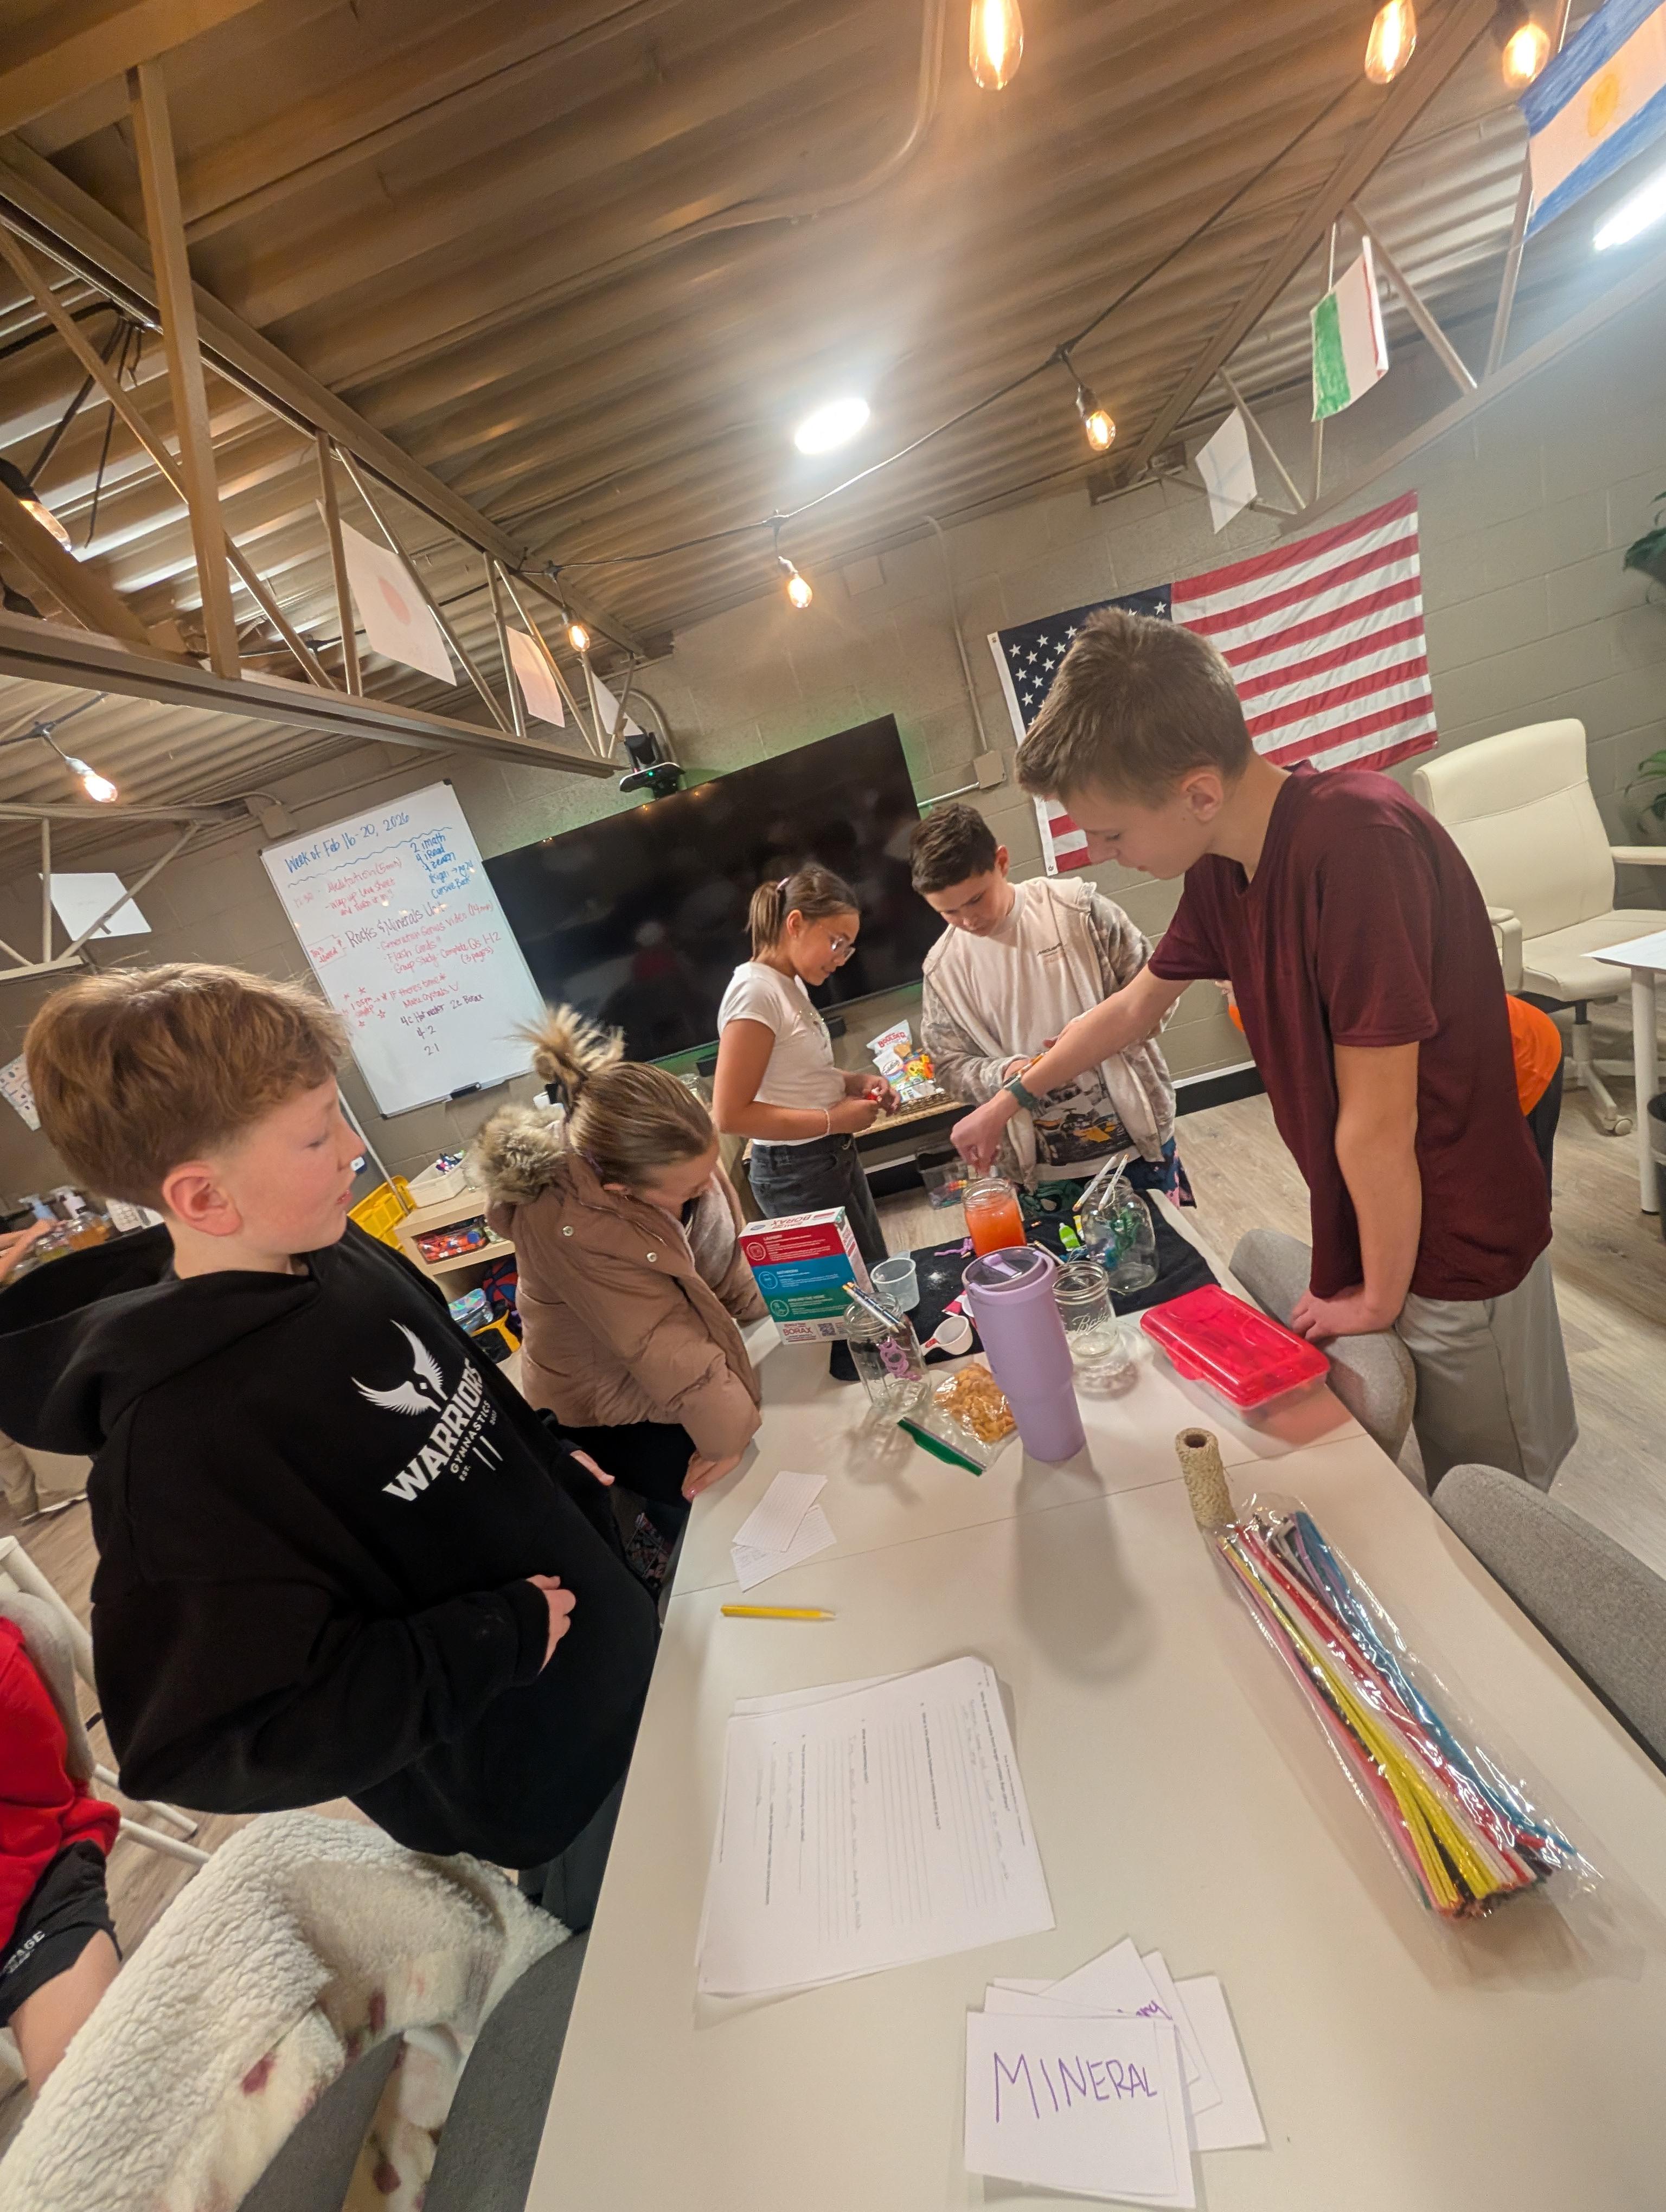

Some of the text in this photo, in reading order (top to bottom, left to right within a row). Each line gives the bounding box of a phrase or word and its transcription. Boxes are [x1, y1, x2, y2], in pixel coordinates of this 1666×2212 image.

[285, 852, 310, 873] Week
[311, 845, 321, 860] of
[323, 838, 340, 857] Feb
[383, 812, 409, 831] 2026
[345, 927, 377, 948] Rocks
[384, 909, 424, 936] Minerals
[783, 1326, 814, 1336] BORAX
[381, 1358, 483, 1502] WARRIORS
[450, 1400, 491, 1474] GYMNASTICS
[994, 2052, 1158, 2124] MINERAL
